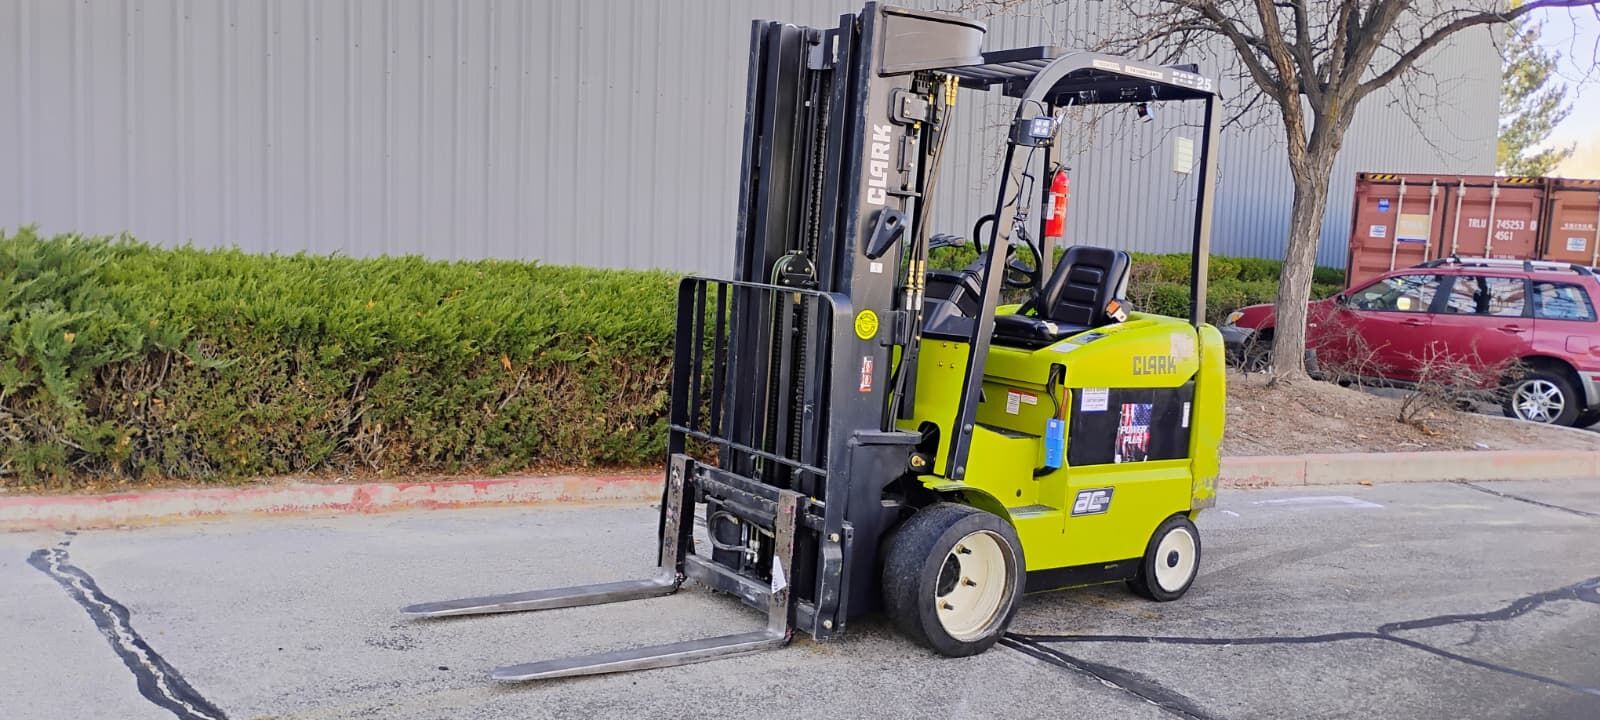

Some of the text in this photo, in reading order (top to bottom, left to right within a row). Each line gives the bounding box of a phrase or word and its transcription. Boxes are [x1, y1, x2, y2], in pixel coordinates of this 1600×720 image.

[1197, 76, 1212, 90] 25
[867, 124, 892, 205] CLARK
[1468, 218, 1487, 229] TRLU
[1496, 219, 1525, 230] 745253
[1494, 231, 1514, 241] 45G1
[1132, 355, 1177, 376] CLARK
[1120, 425, 1147, 434] POWER
[1123, 436, 1143, 444] PLUS
